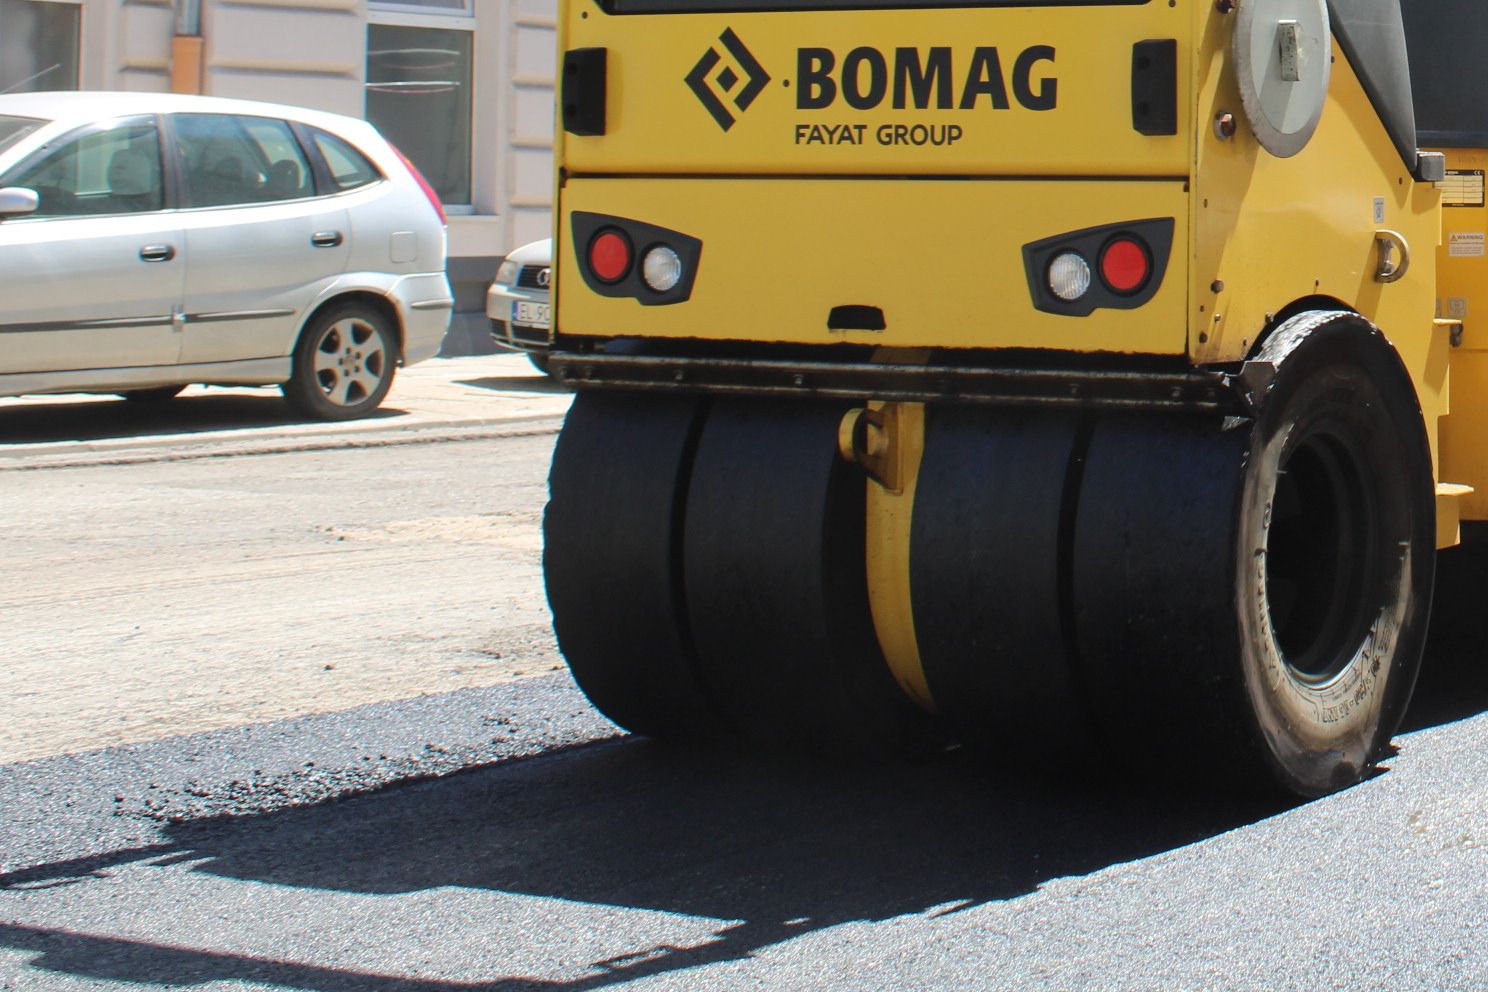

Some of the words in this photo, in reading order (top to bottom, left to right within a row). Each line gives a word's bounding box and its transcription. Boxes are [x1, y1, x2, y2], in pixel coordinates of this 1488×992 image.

[796, 45, 1058, 111] BOMAG
[795, 124, 867, 145] FAYAT
[876, 124, 963, 145] GROUP
